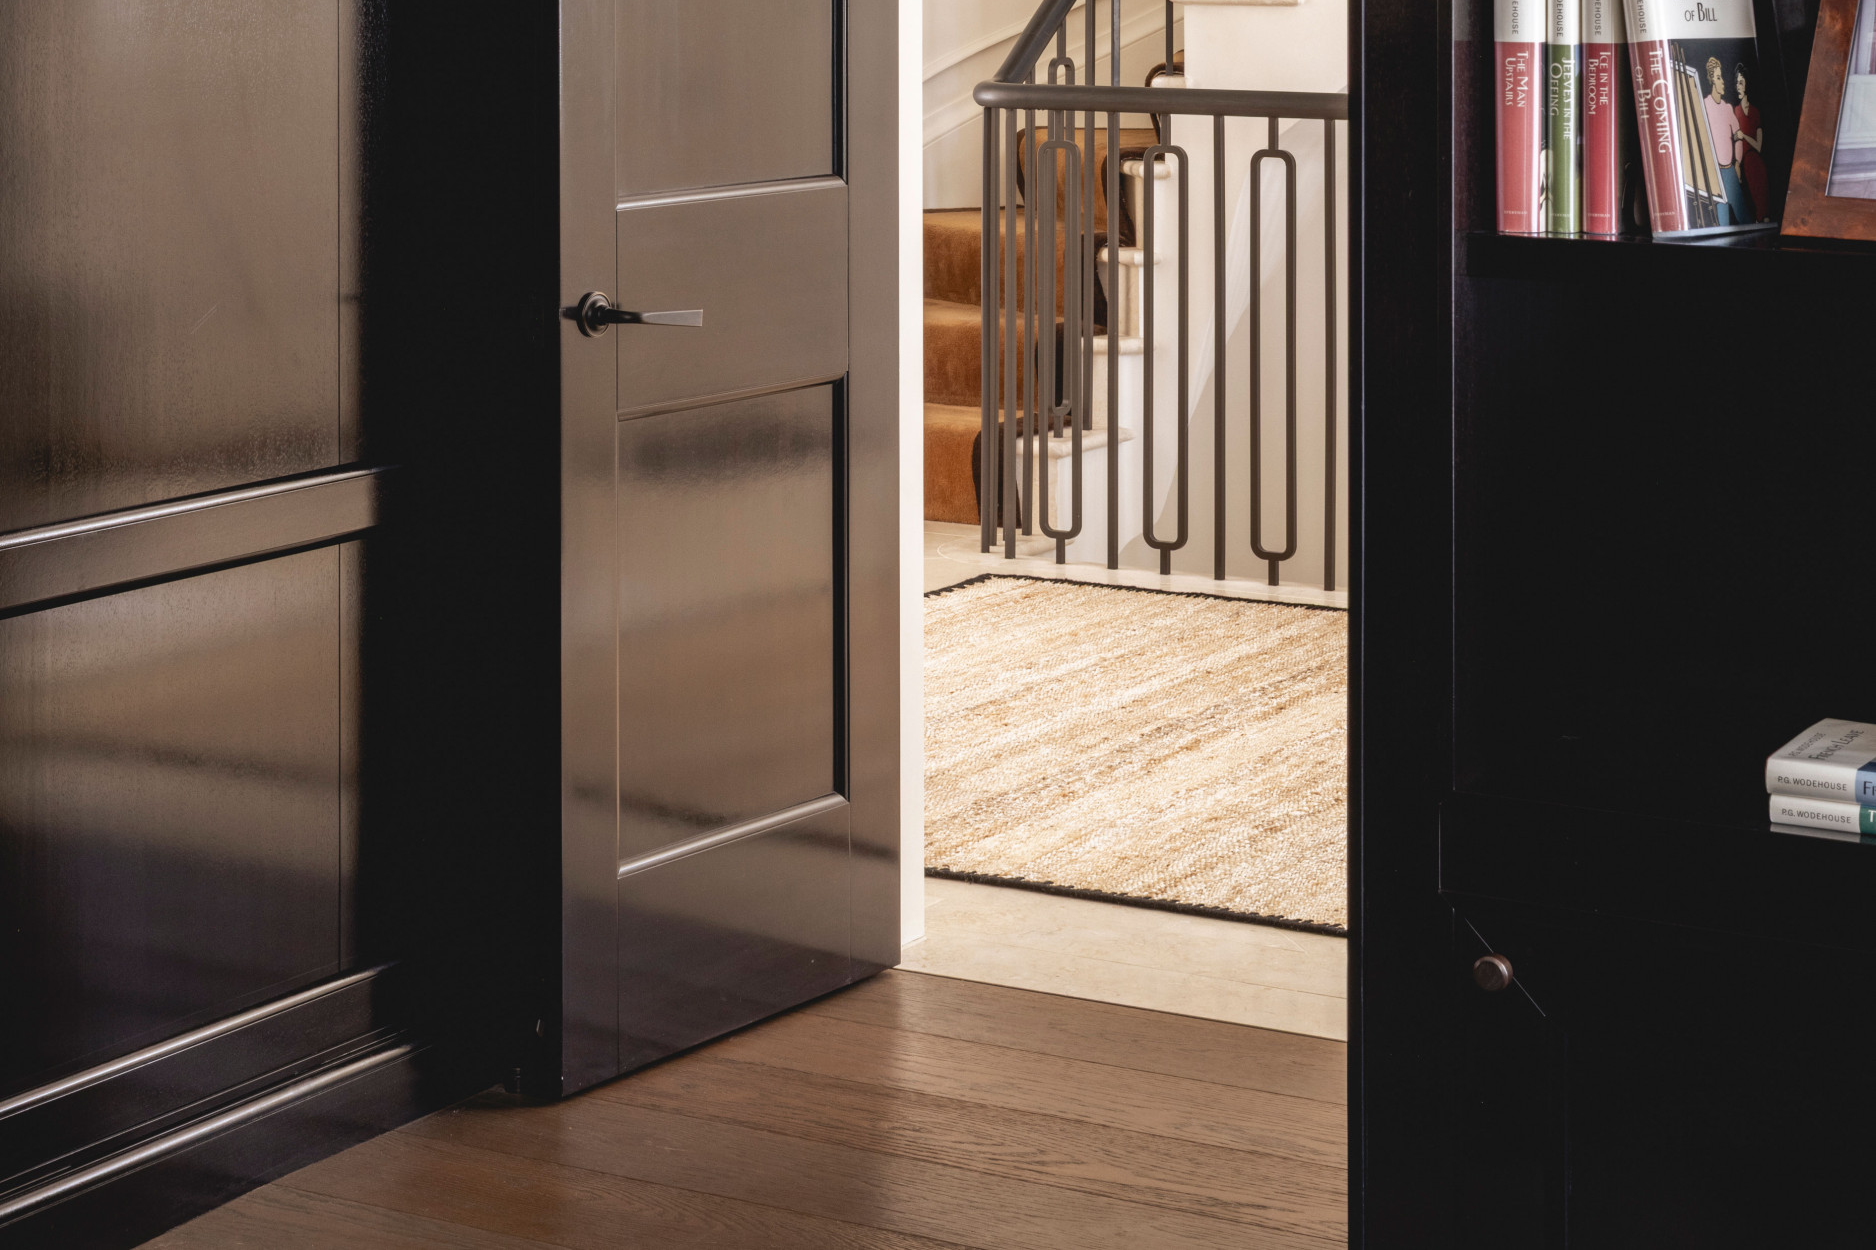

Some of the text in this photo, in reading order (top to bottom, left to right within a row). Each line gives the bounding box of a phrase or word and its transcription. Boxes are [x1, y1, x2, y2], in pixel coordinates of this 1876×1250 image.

[1684, 2, 1717, 21] OF BILL
[1505, 57, 1516, 106] UPSTAIRS
[1517, 51, 1529, 108] THE MAN
[1550, 62, 1562, 116] OFFING
[1562, 57, 1575, 140] JEEVES IN THE
[1588, 59, 1599, 115] BEDROOM
[1600, 51, 1611, 105] ICE IN THE
[1635, 66, 1651, 119] OF BILL
[1649, 48, 1672, 154] THE COMING
[1793, 778, 1848, 791] WODEHOUSE
[1797, 810, 1852, 824] WODEHOUSE
